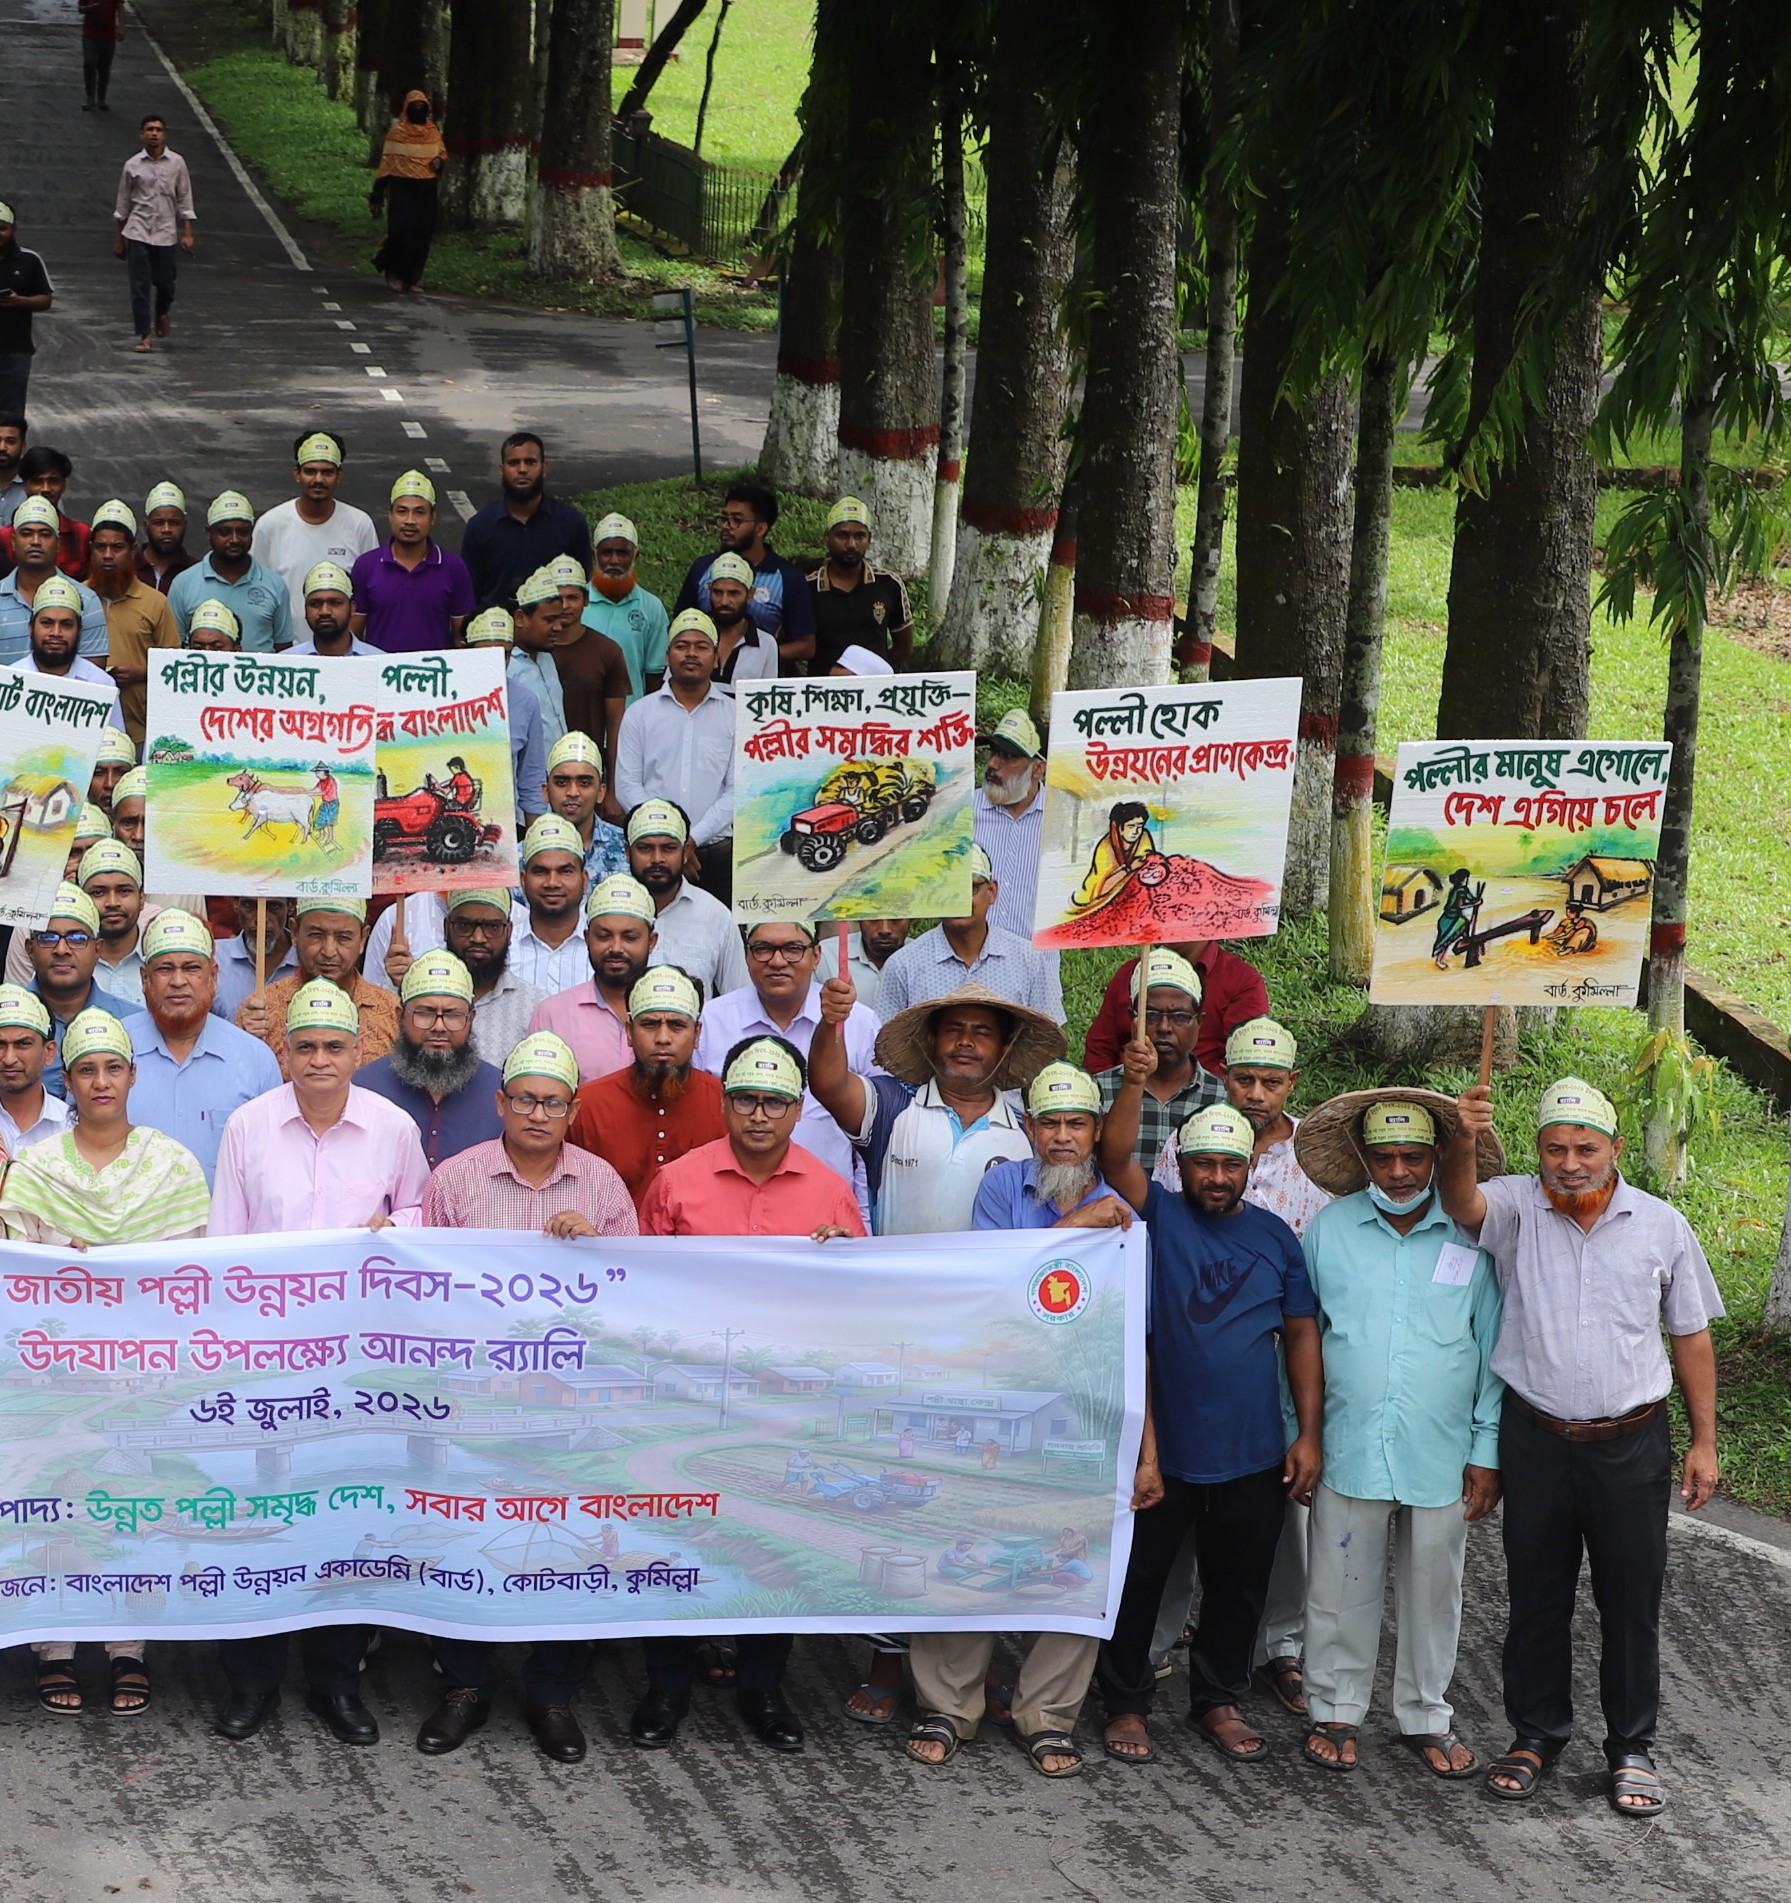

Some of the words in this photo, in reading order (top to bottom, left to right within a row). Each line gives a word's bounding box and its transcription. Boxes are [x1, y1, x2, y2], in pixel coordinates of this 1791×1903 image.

[161, 653, 229, 697] পল্লীর
[233, 655, 327, 705] উন্নয়ন,
[381, 656, 459, 700] পল্লী,
[24, 688, 113, 729] বাংলাদেশ
[400, 686, 508, 738] বাংলাদেশ
[745, 685, 802, 723] কৃষি,
[801, 683, 871, 714] শিক্ষা,
[1072, 692, 1148, 739] পল্লী
[1150, 700, 1223, 739] হোক
[199, 705, 276, 744] দেশের
[278, 704, 375, 754] অগ্রগতি
[743, 718, 812, 762] পল্লীর
[814, 721, 913, 764] সমৃদ্ধির
[917, 709, 976, 754] শক্তি
[1085, 741, 1190, 784] উন্নয়নের
[1403, 745, 1489, 792] পল্লীর
[1494, 749, 1570, 788] মানুষ
[1567, 748, 1670, 786] এগোলে,
[1444, 791, 1505, 827] দেশ
[1504, 790, 1598, 831] এগিয়ে
[1602, 790, 1663, 830] চলে
[321, 878, 360, 896] কুমিল্লা
[762, 892, 818, 915] কুমিল্লা
[1571, 976, 1636, 1003] কুমিল্লা
[904, 1158, 919, 1168] 1971
[136, 1263, 213, 1316] পল্লী
[222, 1264, 348, 1318] উন্নয়ন
[358, 1255, 627, 1309] দিবস-২০২৬”
[1199, 1256, 1237, 1290] NIKE
[18, 1329, 179, 1373] উদযাপন
[188, 1328, 350, 1372] উপলক্ষ্যে
[359, 1332, 476, 1371] আনন্দ
[485, 1327, 587, 1373] র‍্যালি
[189, 1391, 237, 1426] ৬ই
[245, 1386, 343, 1431] জুলাই,
[354, 1390, 451, 1421] ২০২৬
[84, 1488, 166, 1533] উন্নত
[174, 1486, 238, 1530] পল্লী
[245, 1489, 320, 1526] সমৃদ্ধ
[327, 1485, 395, 1515] দেশ,
[404, 1487, 488, 1523] সবার
[495, 1496, 568, 1523] আগে
[578, 1491, 721, 1523] বাংলাদেশ
[65, 1573, 173, 1596] বাংলাদেশ
[179, 1565, 226, 1598] পল্লী
[233, 1564, 308, 1597] উন্নয়ন
[314, 1554, 412, 1581] একাডেমি
[419, 1560, 495, 1596] (বার্ড),
[502, 1563, 619, 1594] কোটবাড়ী,
[624, 1561, 701, 1595] কুমিল্লা
